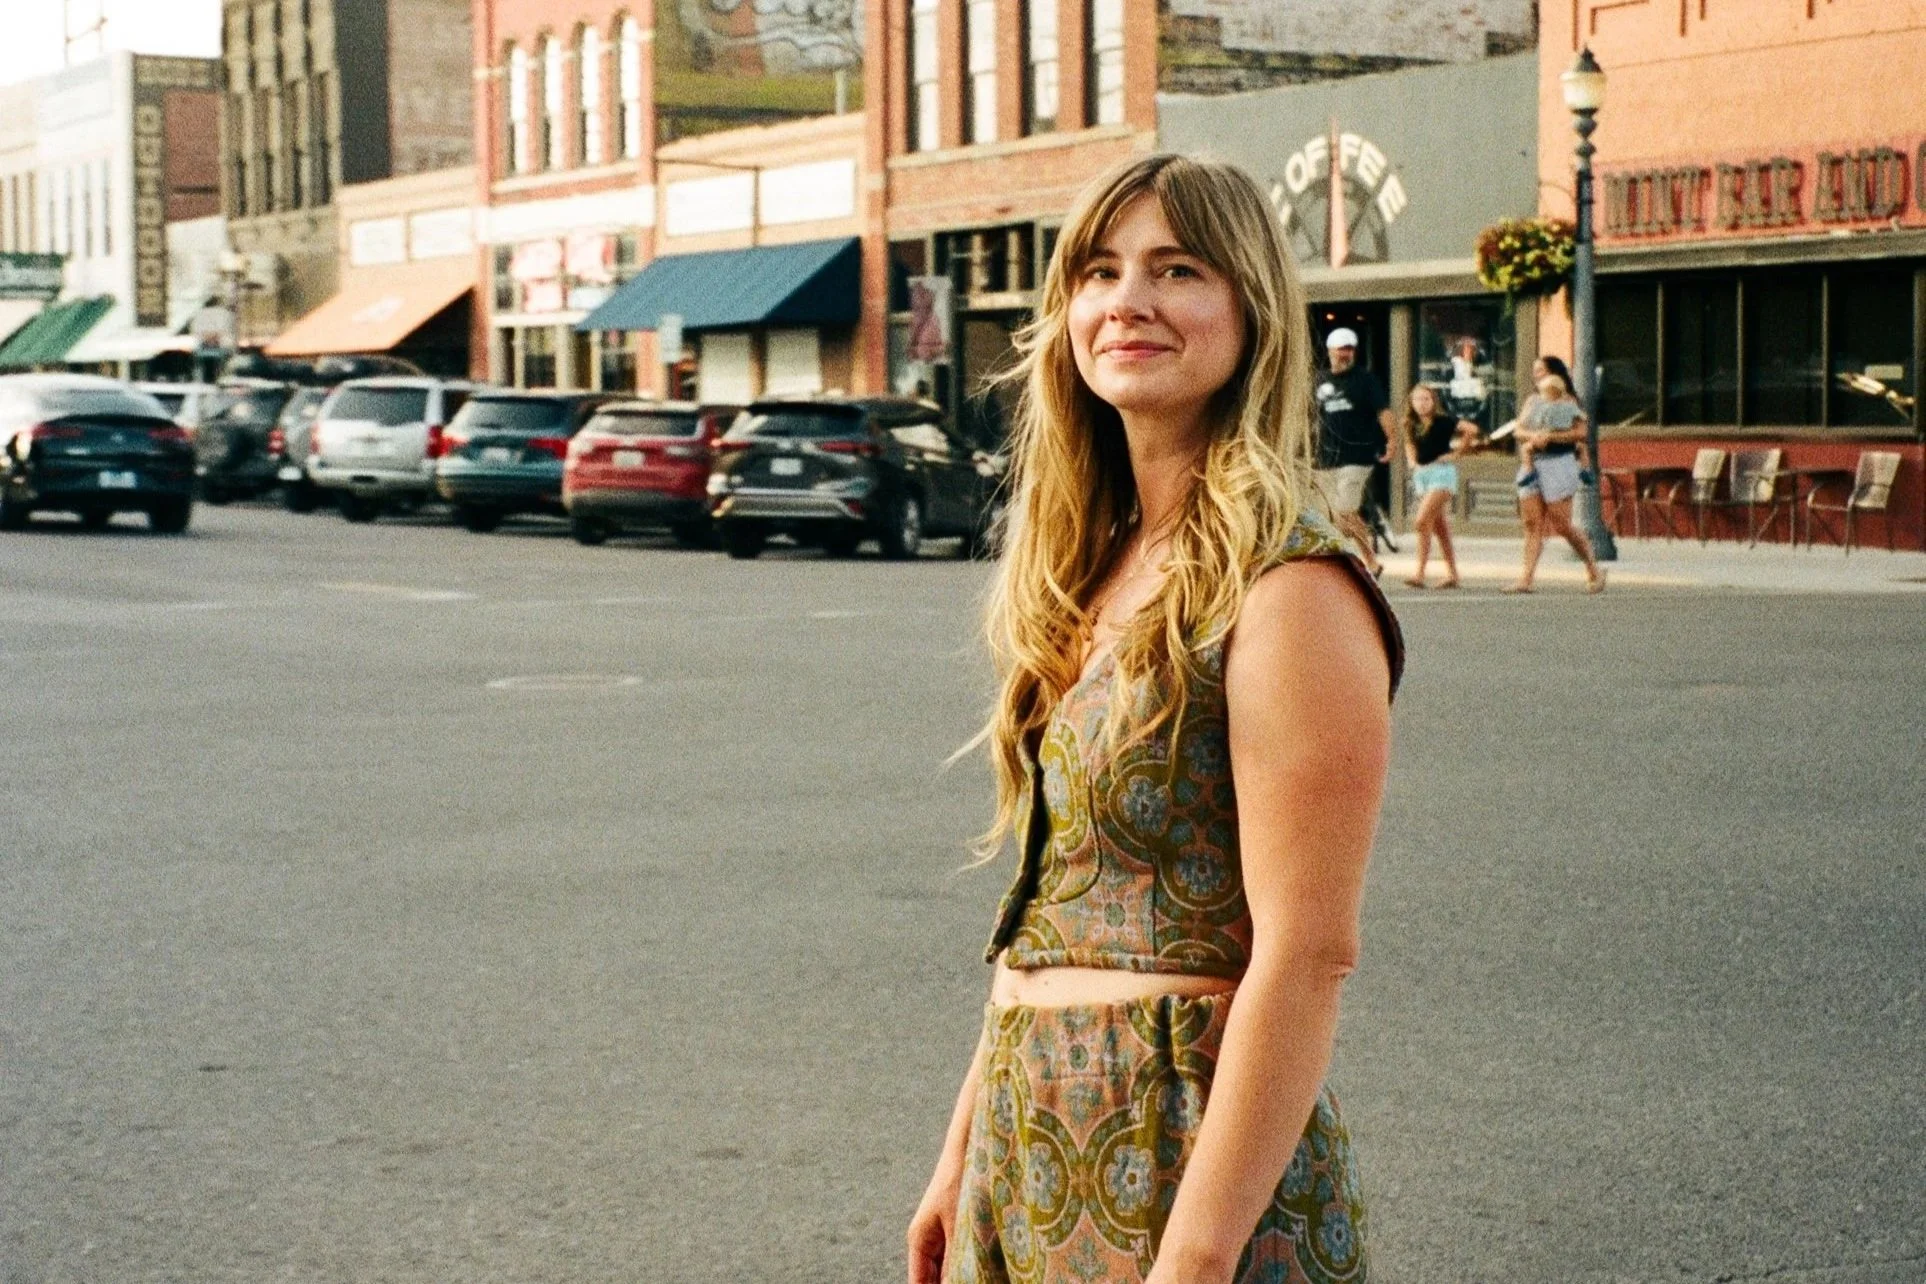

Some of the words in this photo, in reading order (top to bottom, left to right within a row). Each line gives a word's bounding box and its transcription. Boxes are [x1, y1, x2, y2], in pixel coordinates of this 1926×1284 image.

[1603, 167, 1711, 235] MINT
[1714, 155, 1803, 230] BAR
[1812, 146, 1910, 222] AND
